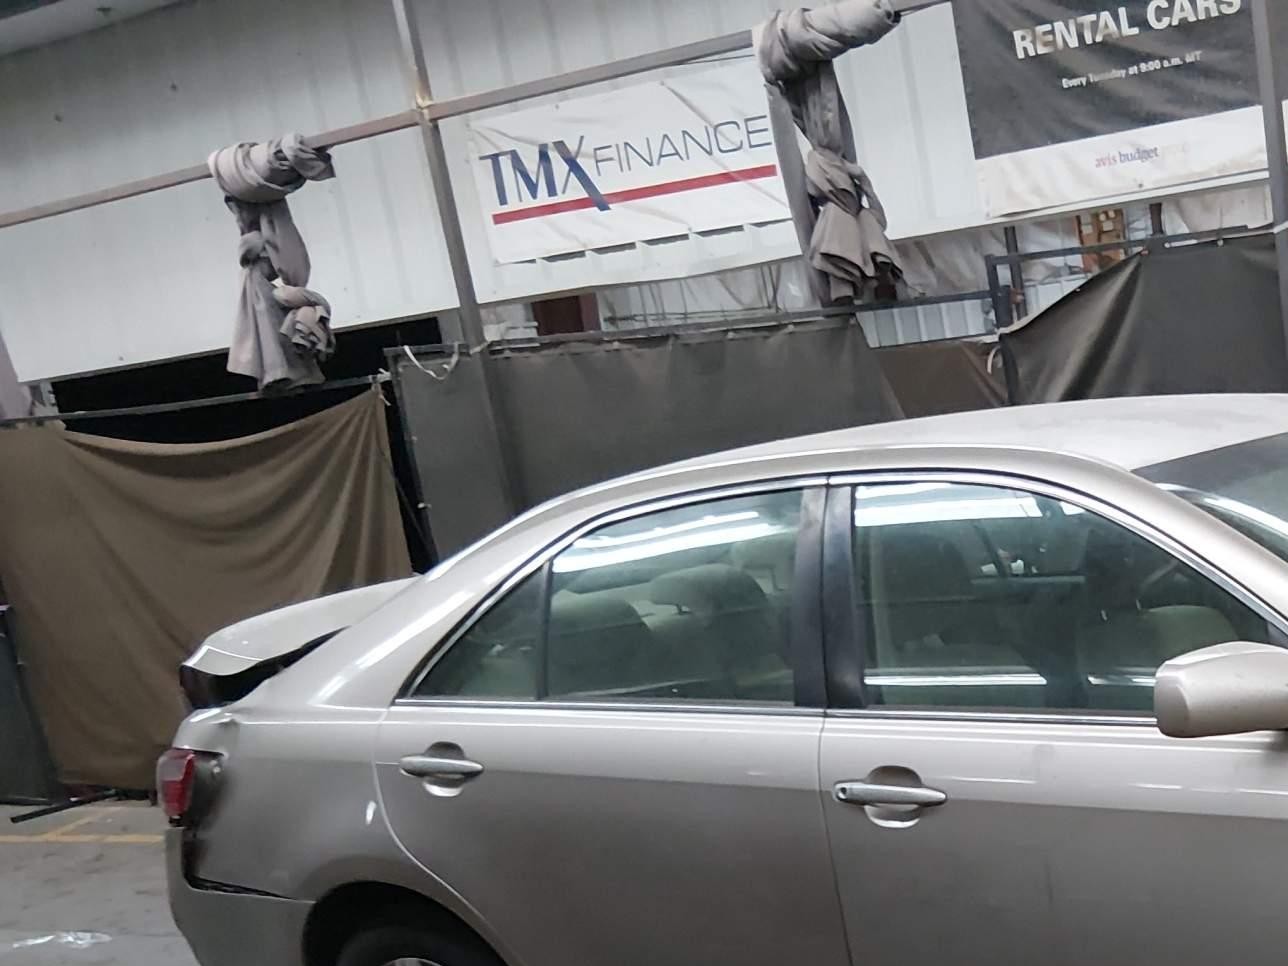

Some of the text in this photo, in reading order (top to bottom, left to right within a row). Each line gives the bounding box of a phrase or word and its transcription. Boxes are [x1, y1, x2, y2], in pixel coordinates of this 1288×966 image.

[1013, 0, 1241, 59] RENTAL CARS
[1128, 65, 1138, 75] at
[479, 115, 773, 211] TMX FINANCE
[1095, 147, 1160, 168] avis budget
